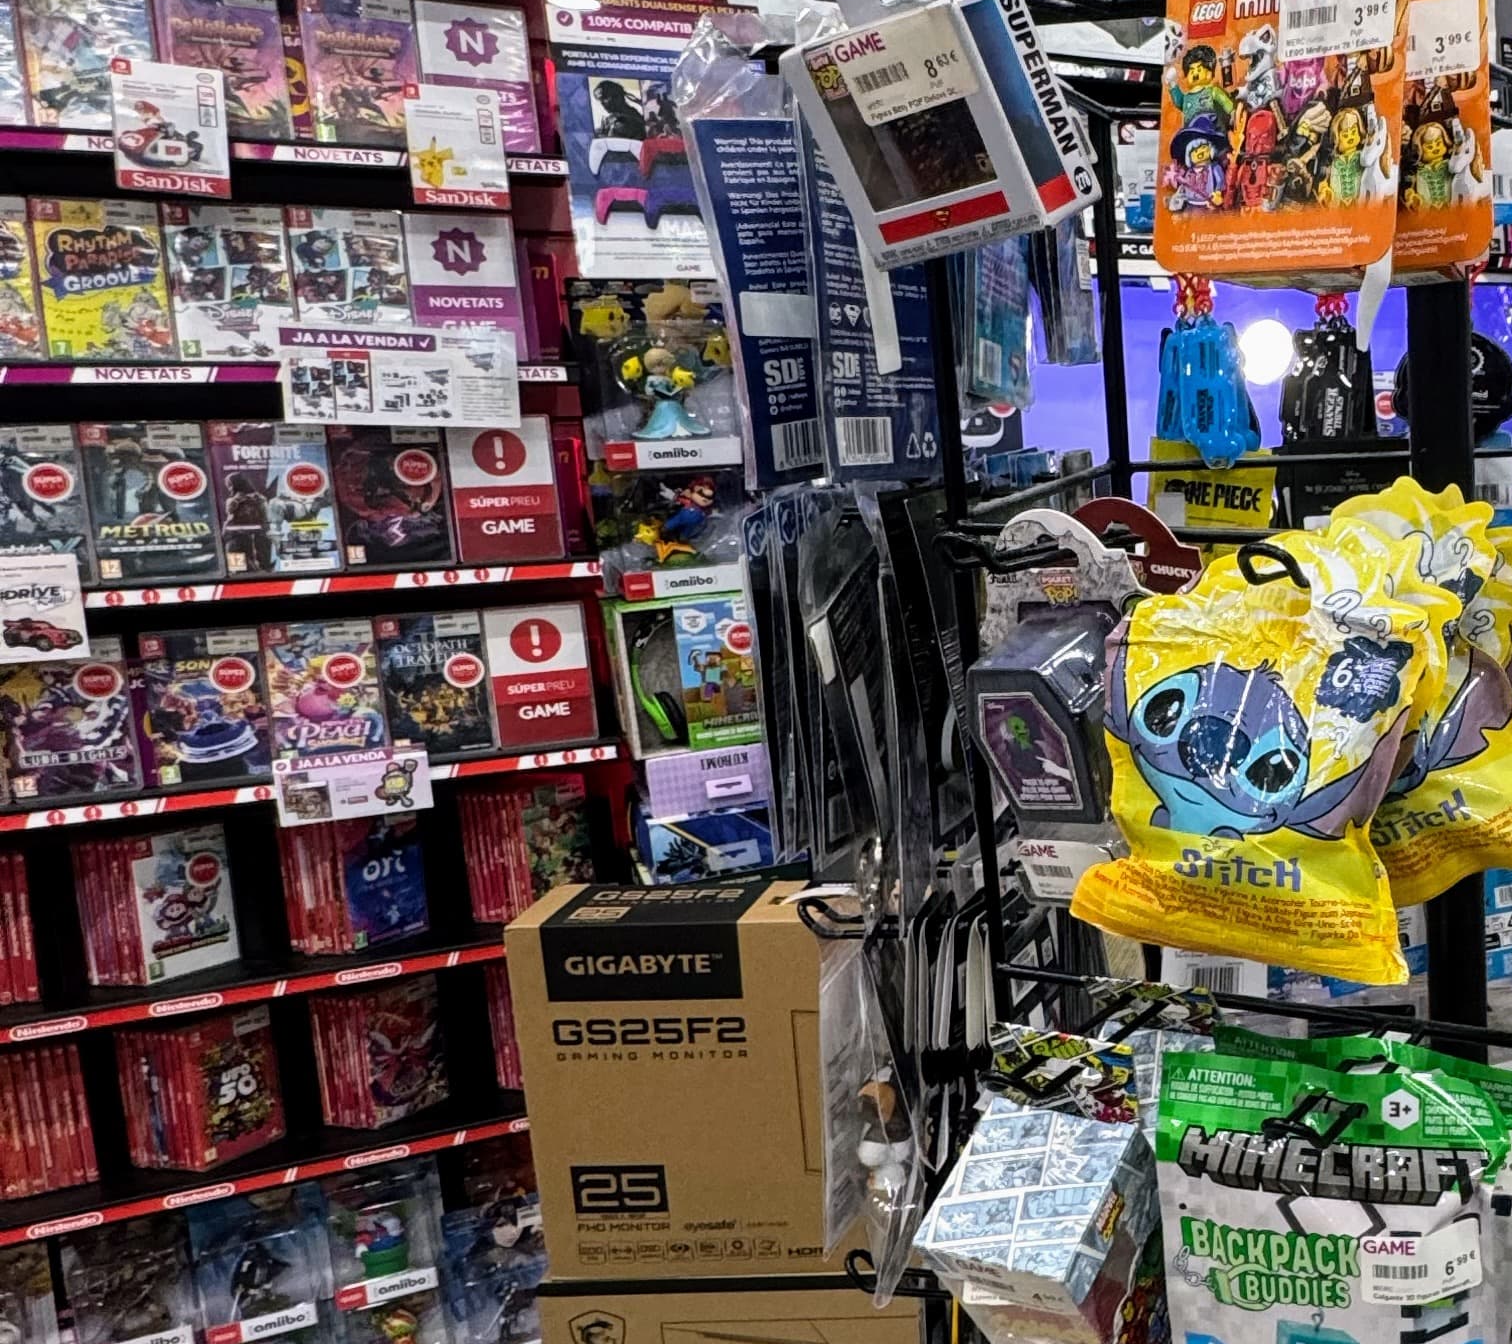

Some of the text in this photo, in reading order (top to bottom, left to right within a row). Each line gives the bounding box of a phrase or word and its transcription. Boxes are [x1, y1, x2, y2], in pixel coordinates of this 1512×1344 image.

[1191, 1, 1227, 25] LEGO
[587, 15, 693, 35] 100% COMPATIB
[834, 31, 888, 65] GAME
[294, 147, 385, 164] NOVETATS
[132, 172, 216, 194] SanDisk
[425, 189, 497, 207] SanDisk
[64, 267, 140, 292] GROOVE
[430, 296, 505, 311] NOVETATS
[292, 332, 314, 348] JA
[332, 334, 352, 348] LA
[355, 333, 414, 350] VENDA!
[95, 366, 192, 382] NOVETATS
[1212, 484, 1263, 512] PIECE
[99, 521, 212, 540] METROID
[482, 521, 535, 537] GAME
[1151, 564, 1198, 581] CHUCKY
[396, 637, 468, 655] OCTOPATH
[519, 701, 572, 720] GAME
[342, 750, 387, 764] VENDA
[1019, 842, 1057, 858] GAME
[564, 953, 712, 976] GIGABYTE
[552, 1016, 748, 1047] GS25F2
[556, 1049, 749, 1063] GAMING MONITOR
[1187, 1067, 1257, 1090] ATTENTION:
[1386, 1102, 1412, 1120] 3+
[1179, 1124, 1490, 1207] MINECRAFT
[579, 1172, 661, 1209] 25
[609, 1221, 672, 1233] MONITOR
[1186, 1216, 1362, 1279] BACKPACK
[1362, 1239, 1417, 1256] GAME
[378, 1274, 428, 1296] amiibo
[1246, 1274, 1352, 1309] BUDDIES
[252, 1312, 306, 1336] amiibo
